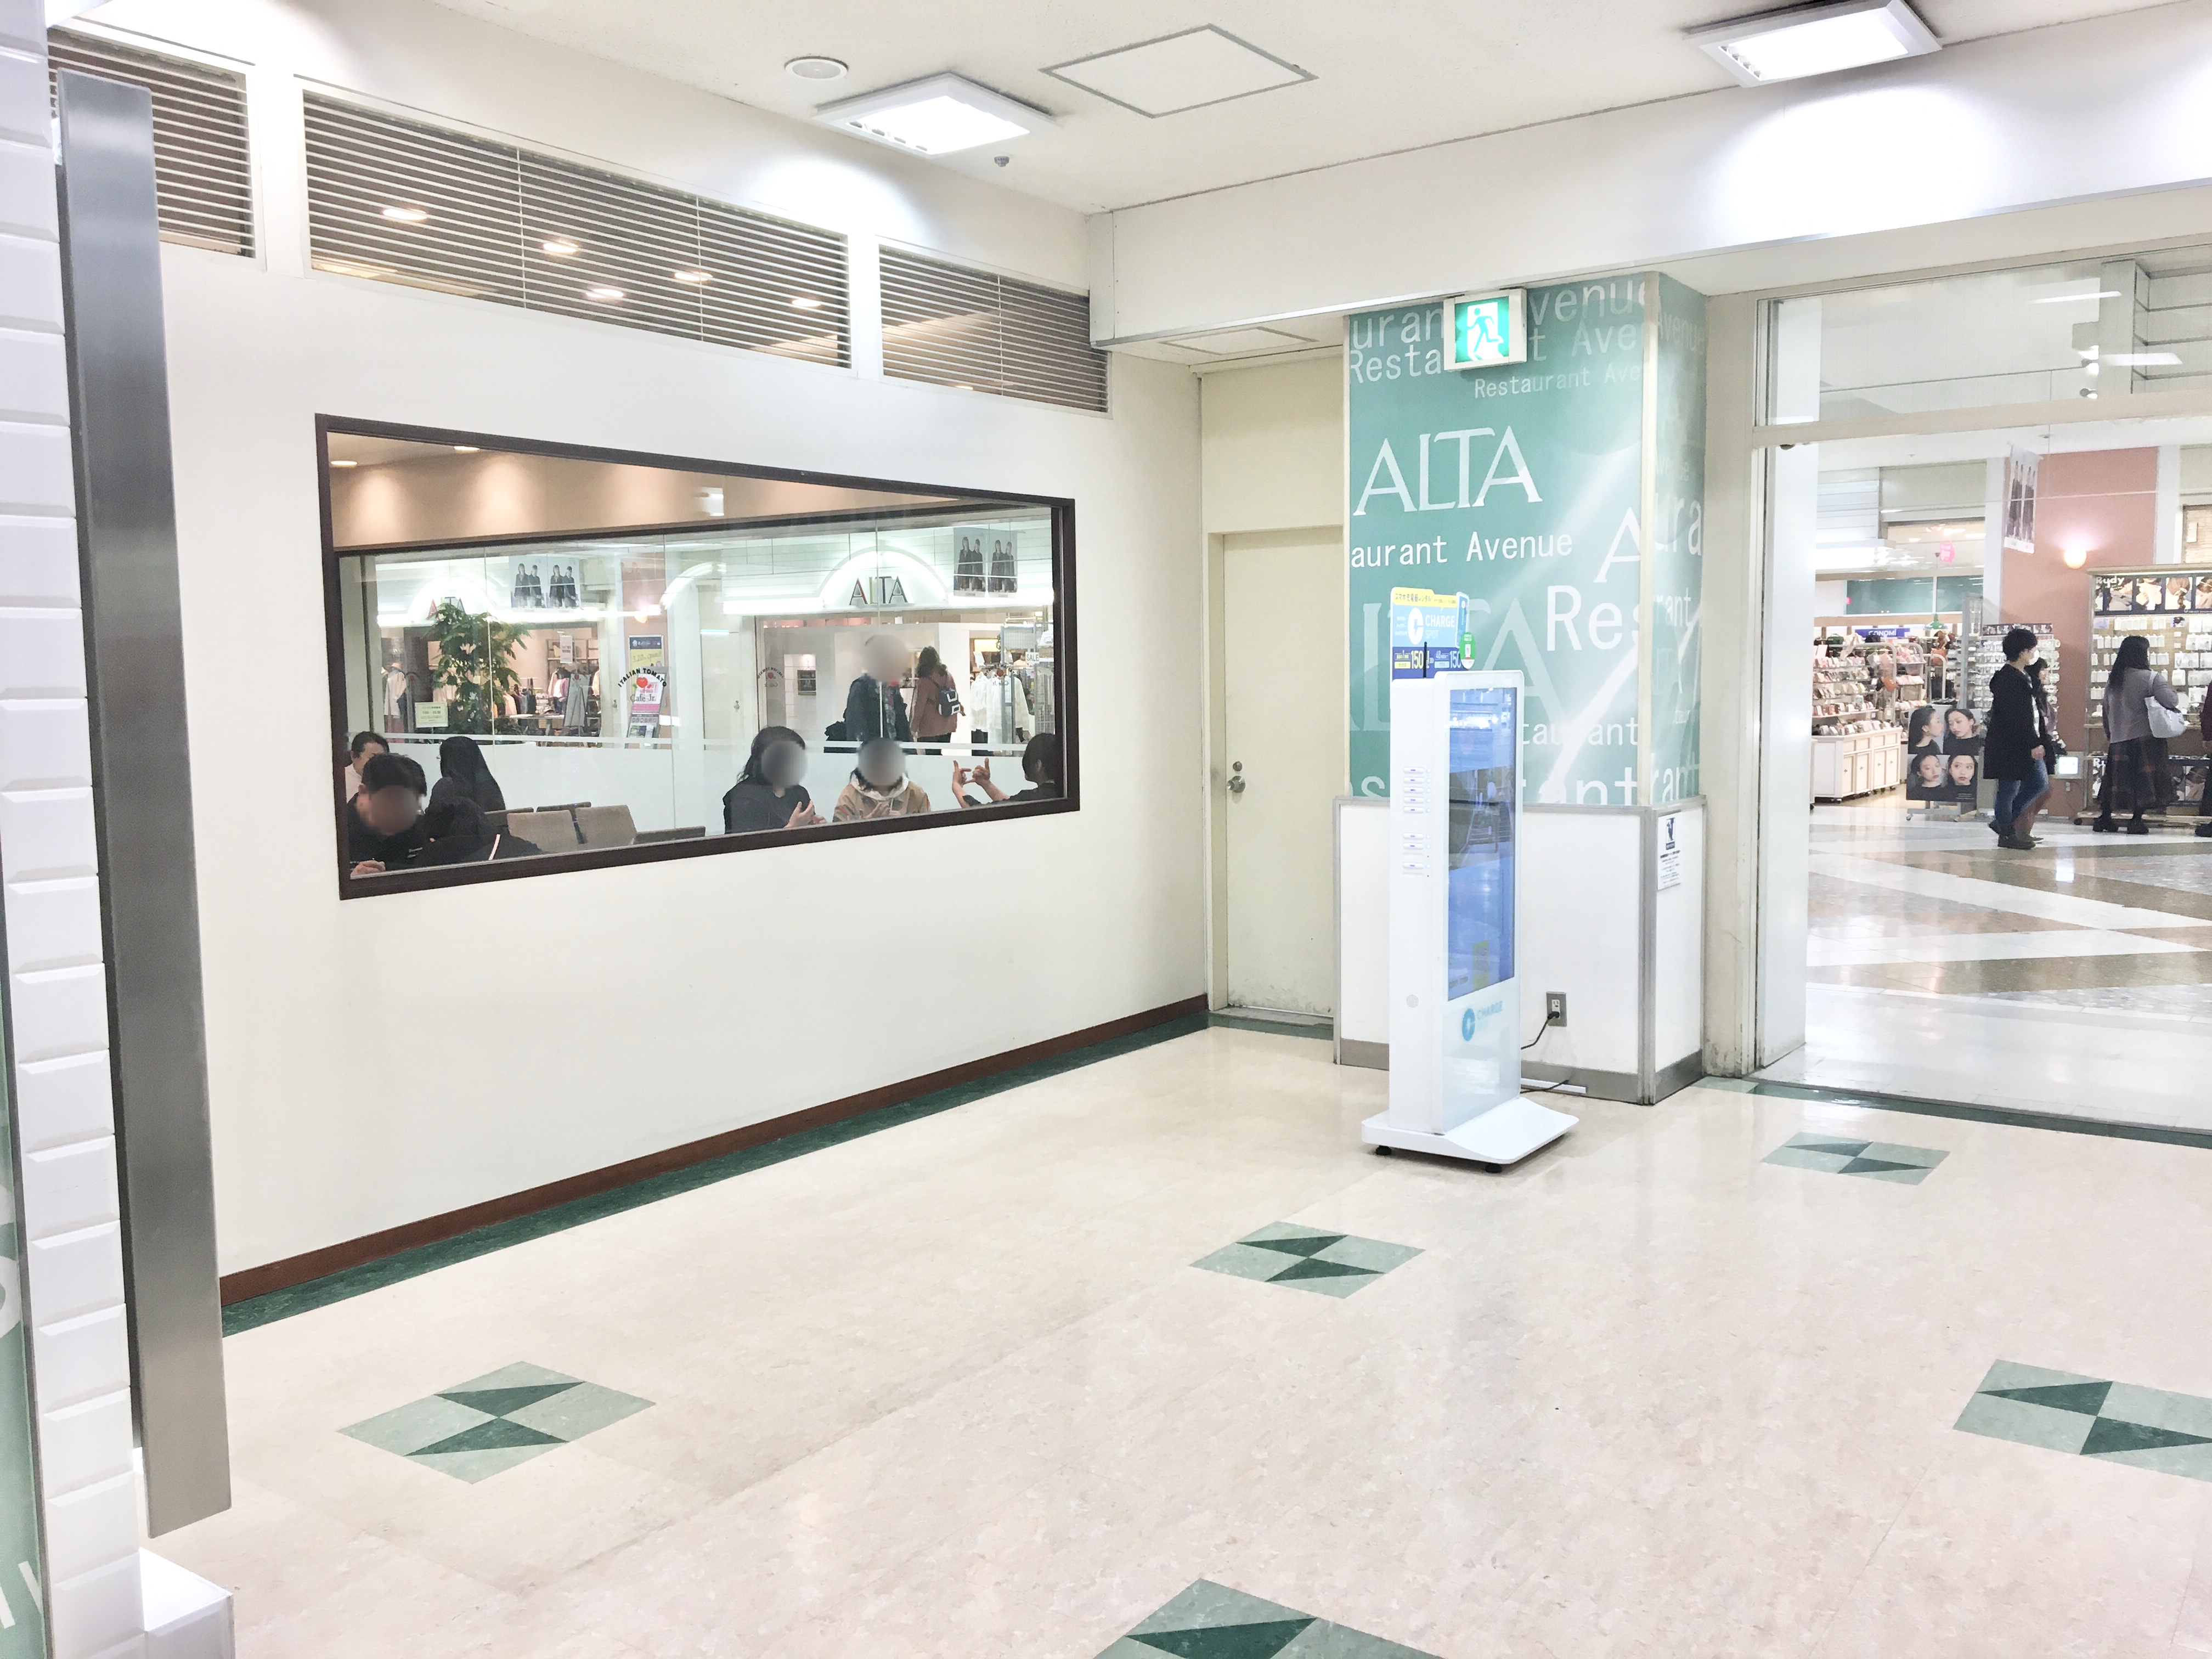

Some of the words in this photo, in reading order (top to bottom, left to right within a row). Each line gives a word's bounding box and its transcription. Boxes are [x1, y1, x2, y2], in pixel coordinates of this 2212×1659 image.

[1475, 367, 1591, 398] Restaurant
[1353, 426, 1543, 516] ALTA
[1351, 536, 1448, 568] aurant
[1466, 531, 1573, 561] Avenue
[849, 575, 909, 605] ALTA
[1425, 614, 1456, 628] CHARGE
[1026, 653, 1039, 662] SALE
[618, 668, 641, 688] ITALIAN
[642, 668, 667, 687] TOMATO
[1522, 717, 1639, 745] tauant
